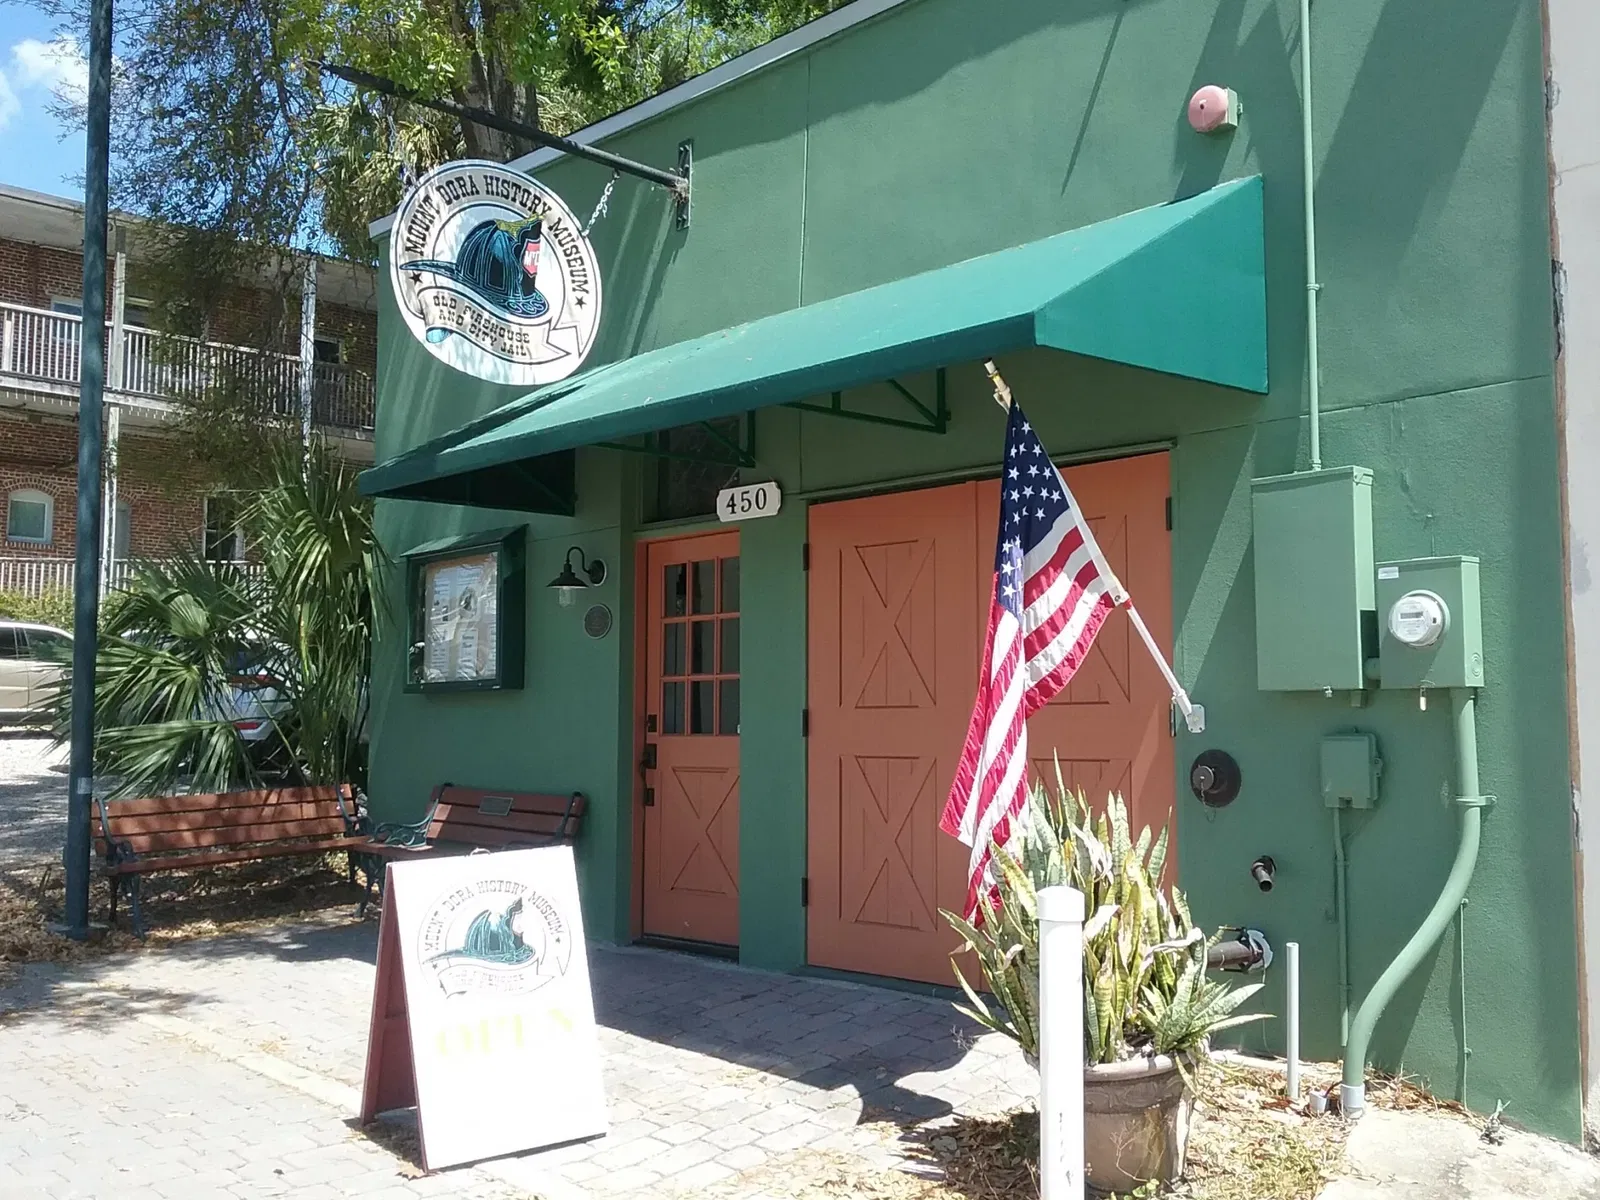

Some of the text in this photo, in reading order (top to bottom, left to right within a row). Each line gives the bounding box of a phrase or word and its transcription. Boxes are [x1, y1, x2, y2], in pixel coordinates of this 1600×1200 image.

[405, 175, 590, 295] MOUNT DORA HISTORY MUSEUM
[433, 295, 531, 344] OLD FIREHOUSE
[438, 308, 527, 357] AND CITY JAIL
[726, 487, 767, 515] 450
[442, 886, 475, 912] DORA
[476, 879, 528, 896] HISTORY
[527, 890, 565, 935] MUSEUM
